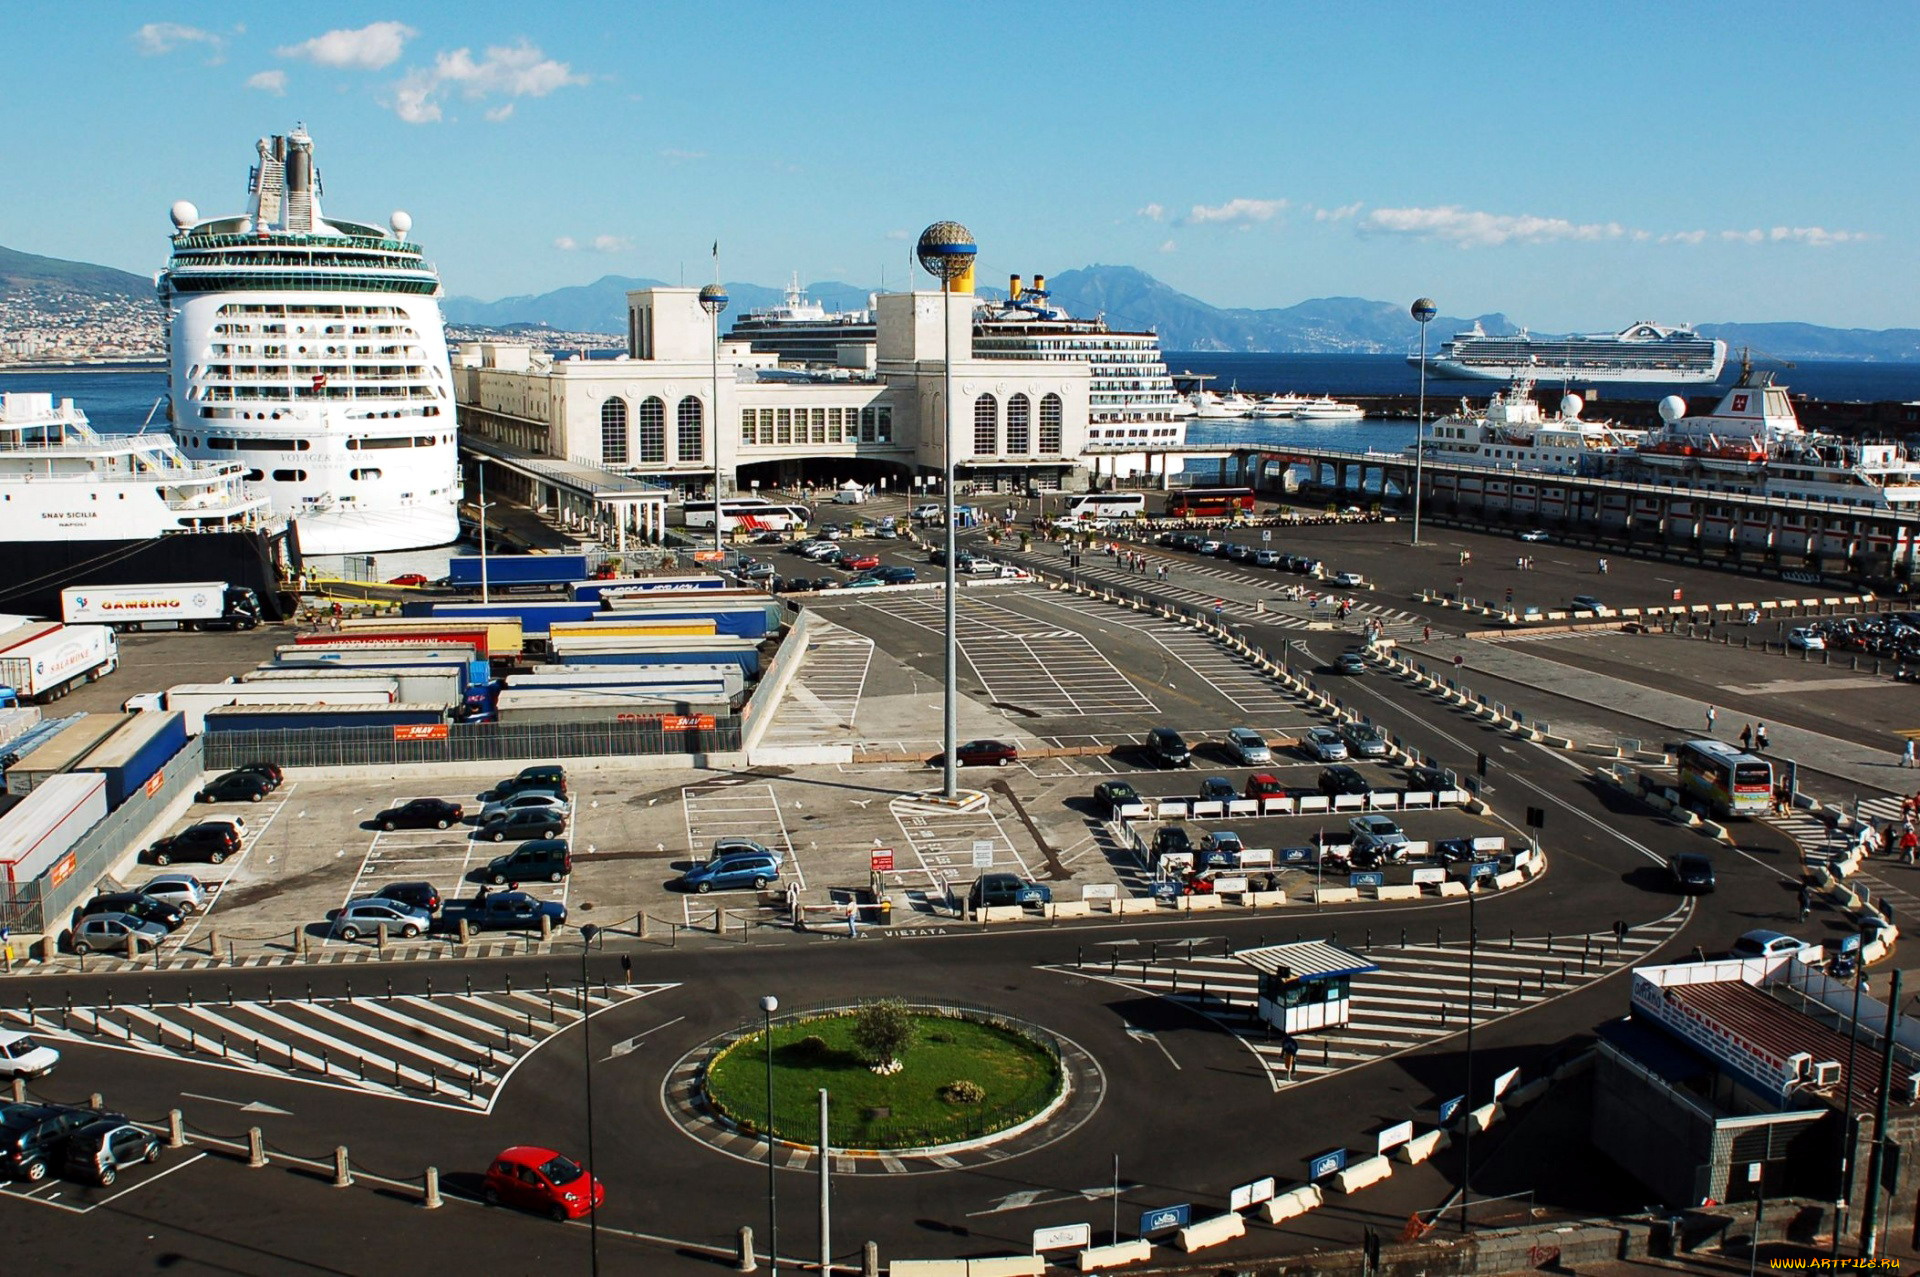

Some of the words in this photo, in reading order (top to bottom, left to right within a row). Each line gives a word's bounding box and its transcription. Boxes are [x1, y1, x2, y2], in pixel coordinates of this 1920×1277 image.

[101, 599, 181, 610] GAMBINO
[677, 717, 701, 726] SNAV
[409, 726, 434, 734] SNAV
[884, 928, 947, 937] VIETATA
